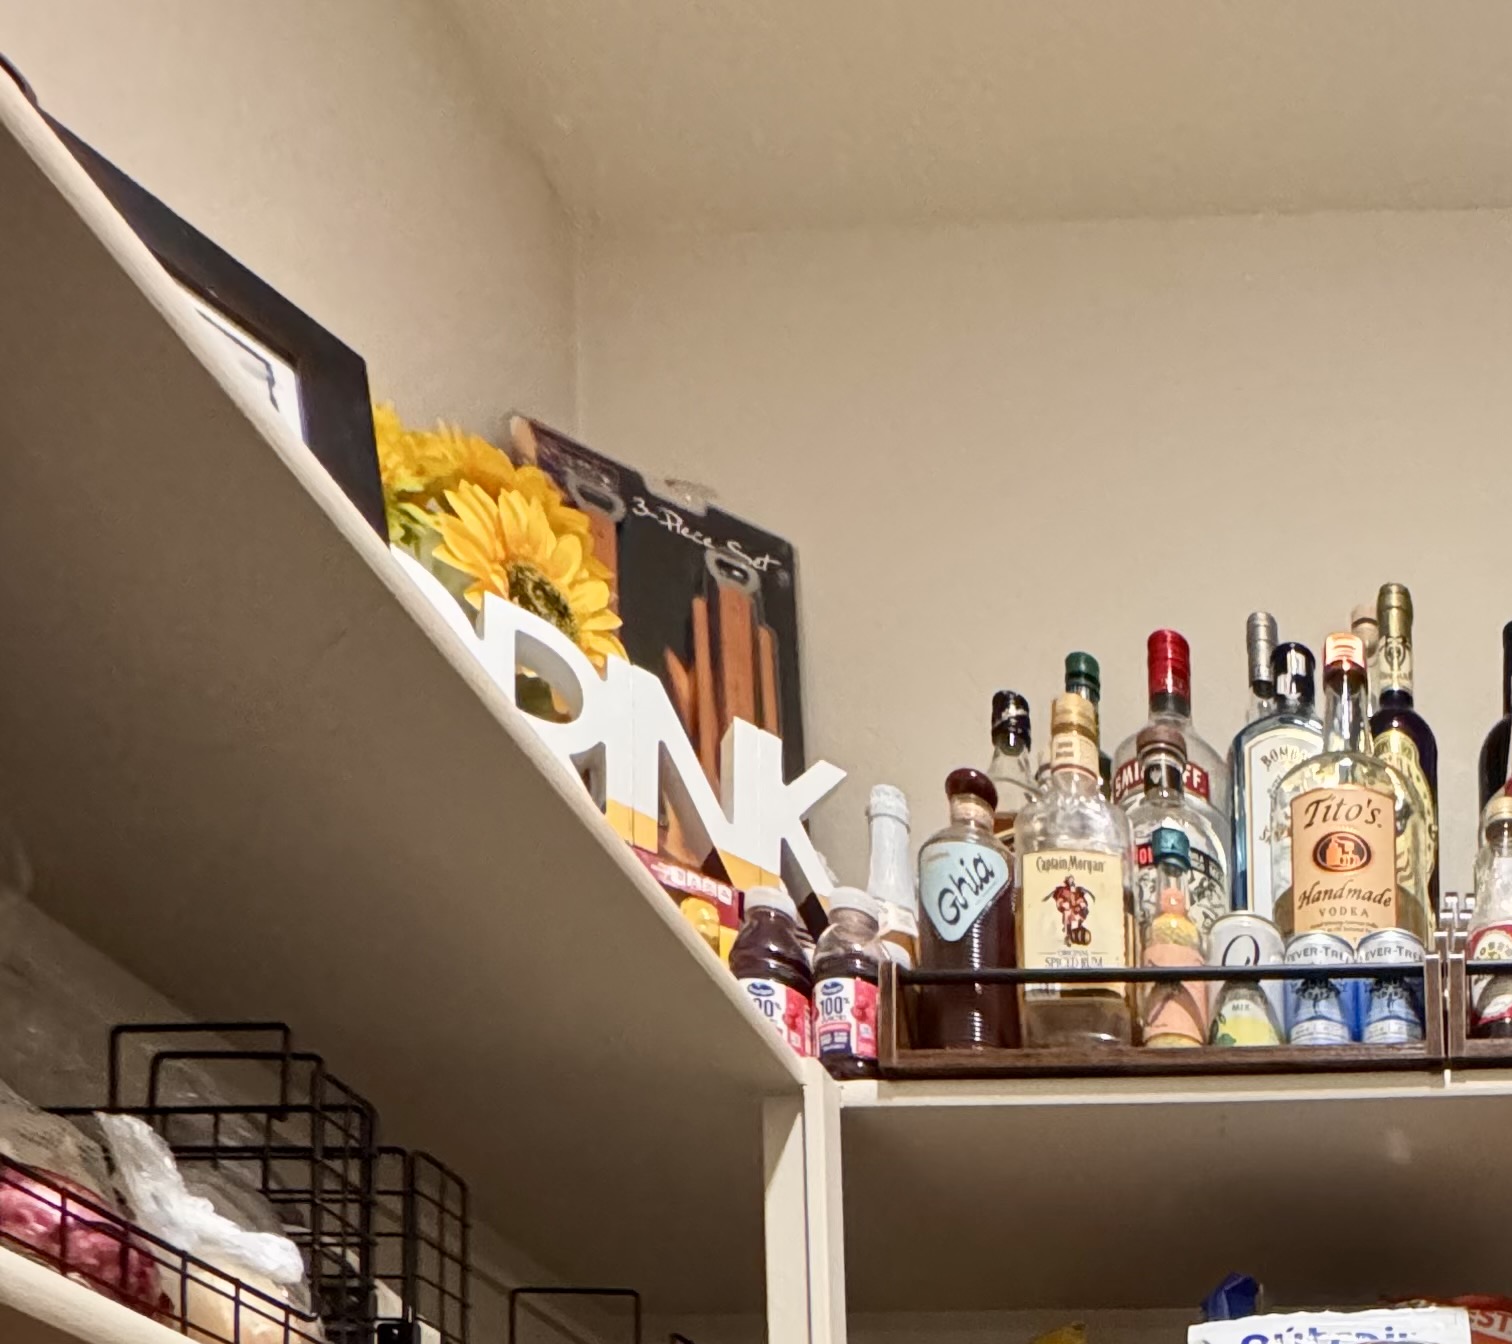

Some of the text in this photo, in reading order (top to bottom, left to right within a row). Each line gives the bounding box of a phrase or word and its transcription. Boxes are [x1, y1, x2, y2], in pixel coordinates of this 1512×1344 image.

[726, 539, 781, 571] Set
[1114, 760, 1203, 794] SMIFF
[1036, 855, 1105, 873] Captain Morgan
[938, 853, 995, 925] Ghia
[1298, 879, 1392, 910] Handmade
[1319, 906, 1369, 918] VODKA
